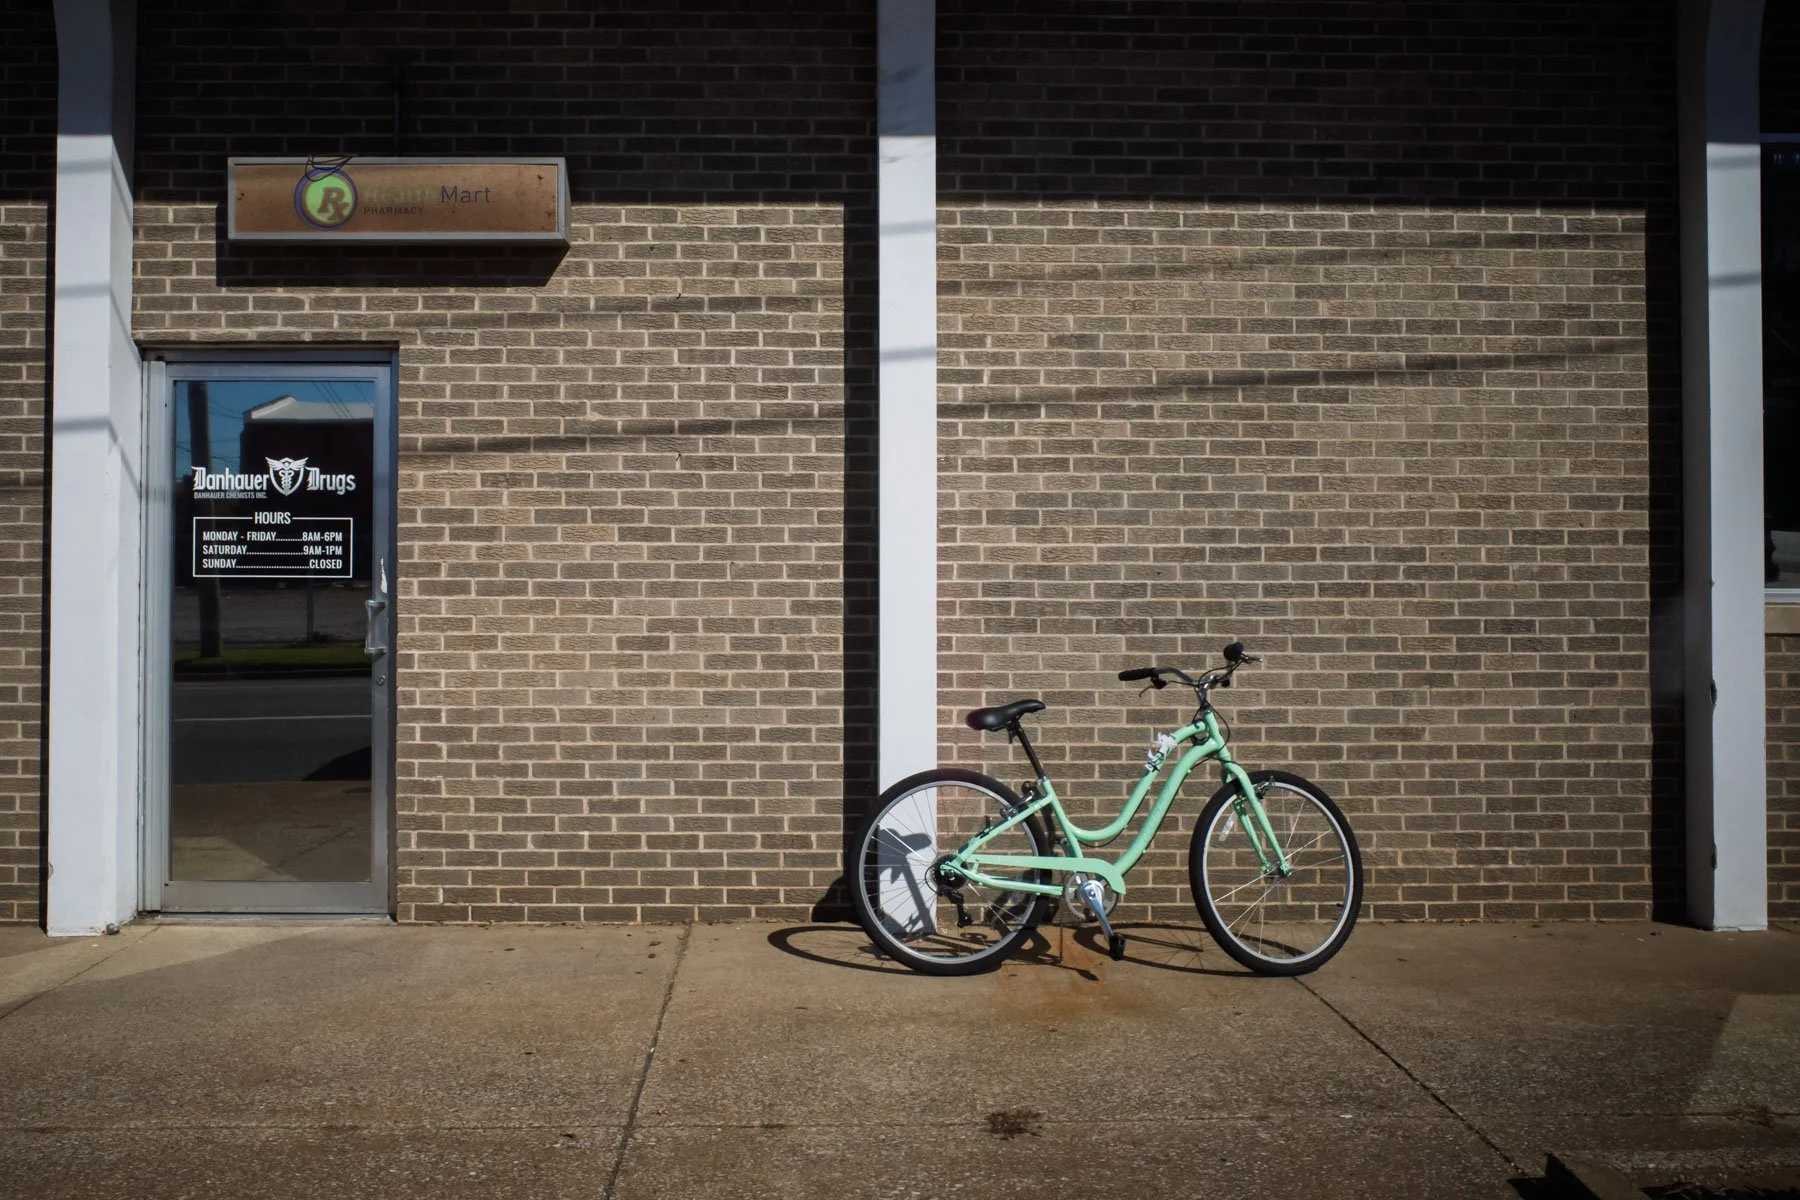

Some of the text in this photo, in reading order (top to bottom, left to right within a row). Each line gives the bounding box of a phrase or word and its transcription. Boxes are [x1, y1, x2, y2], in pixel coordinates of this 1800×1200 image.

[440, 185, 491, 204] Mart
[363, 206, 424, 216] PHARMACY
[191, 466, 357, 496] Danhauer Drugs
[193, 491, 269, 499] DANHAUER CHEMISTS INC.
[254, 511, 292, 525] HOURS
[202, 531, 239, 542] MONDAY
[309, 559, 342, 569] CLOSED
